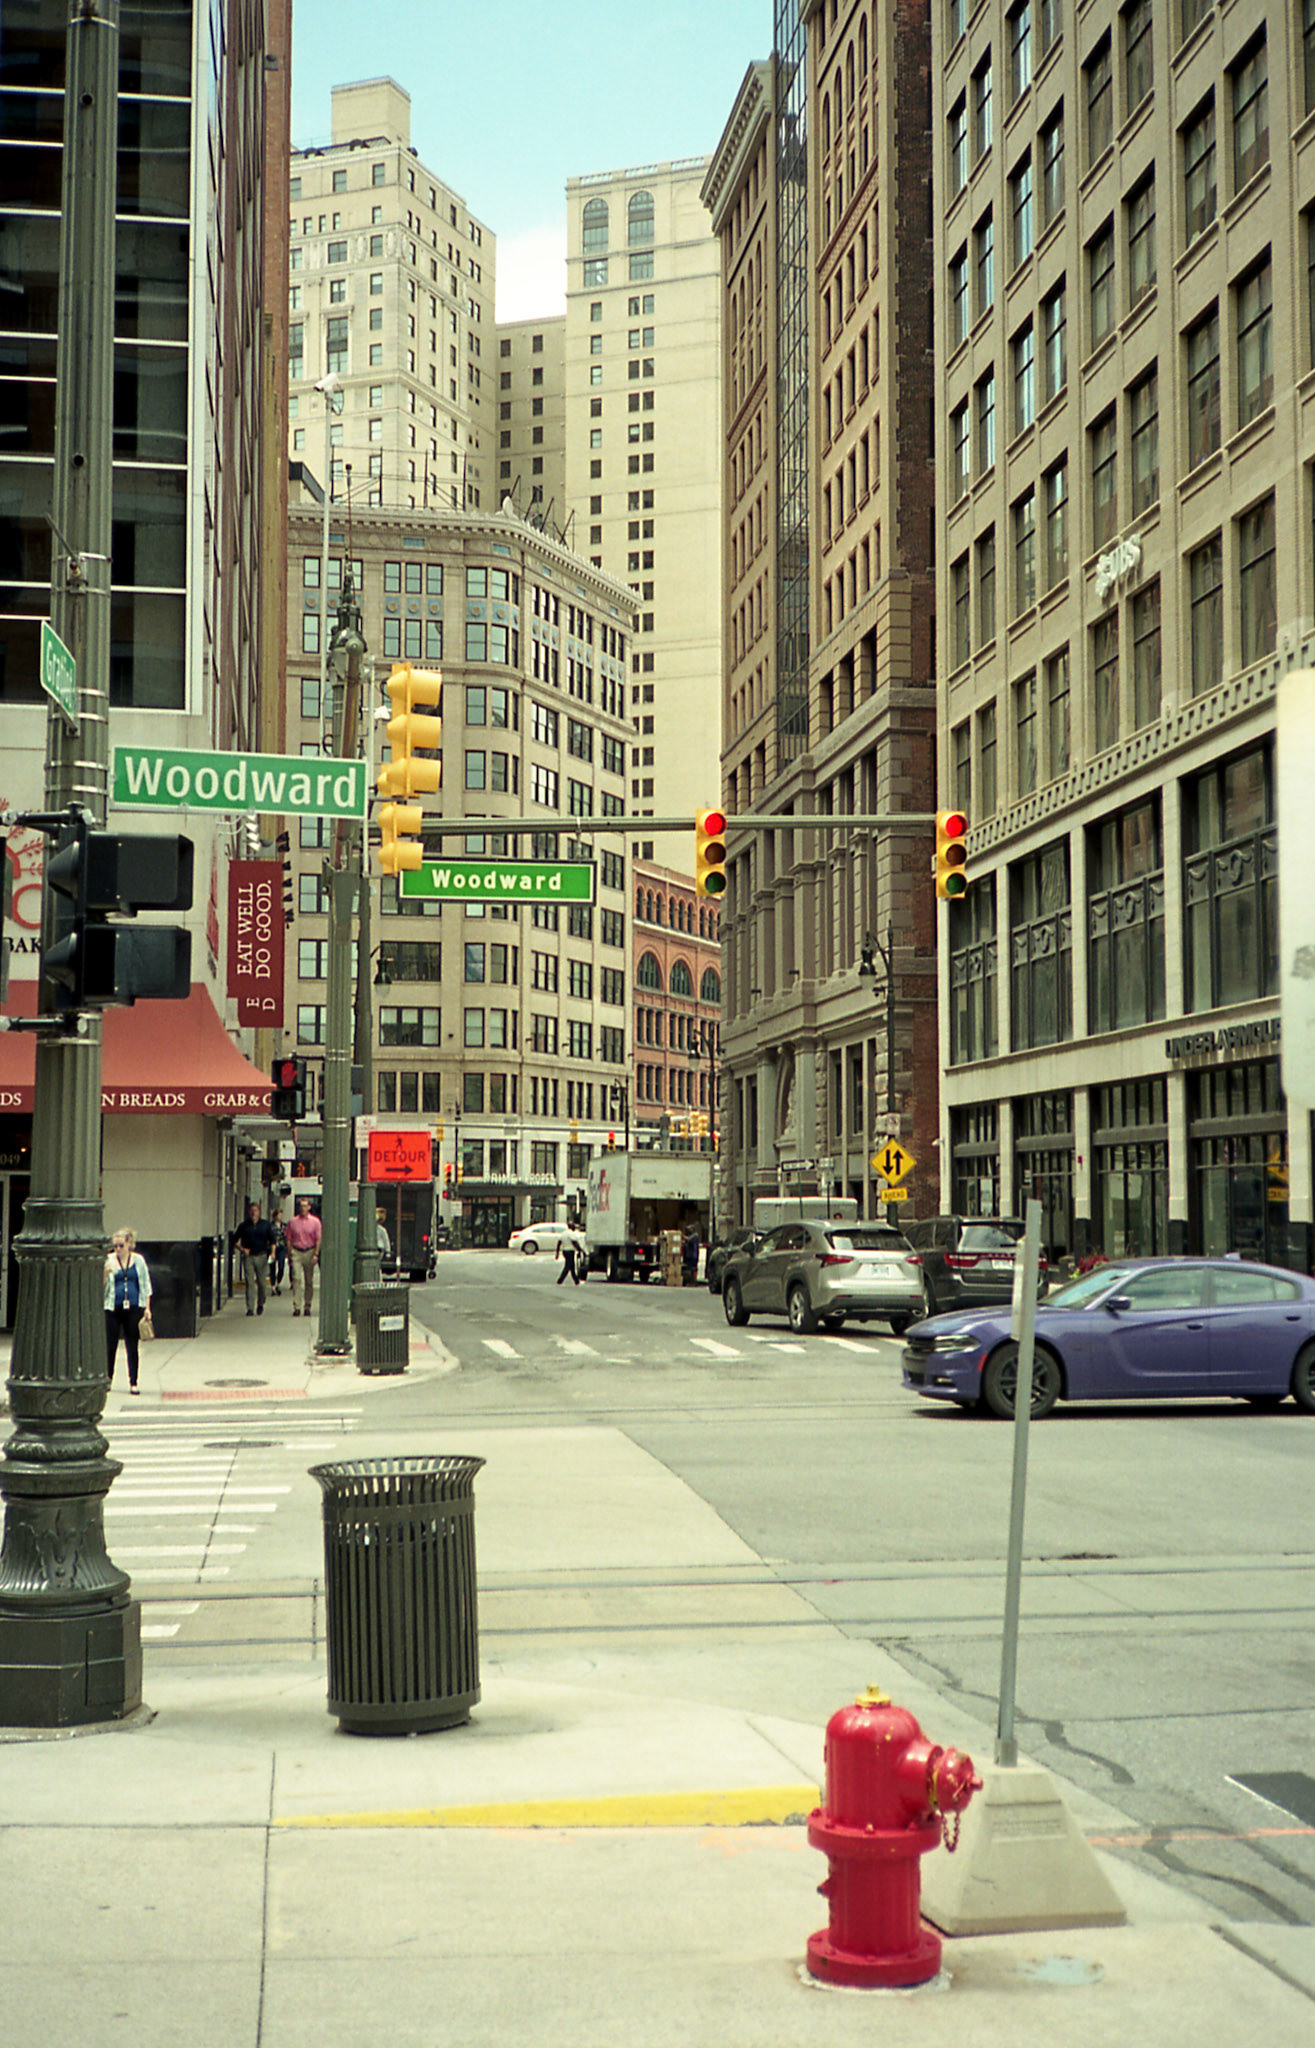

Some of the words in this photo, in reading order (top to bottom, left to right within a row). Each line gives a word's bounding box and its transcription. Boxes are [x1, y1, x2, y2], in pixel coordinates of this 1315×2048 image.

[125, 756, 357, 808] Woodward
[432, 869, 562, 890] Woodward
[238, 883, 254, 935] WELL
[256, 880, 272, 942] GOOD.
[237, 941, 253, 975] EAT
[256, 948, 271, 979] DO
[1165, 1031, 1216, 1058] UNDER
[120, 1093, 186, 1107] BREADS
[204, 1093, 247, 1107] GRAB
[249, 1094, 260, 1107] &
[374, 1151, 425, 1162] DETOUR
